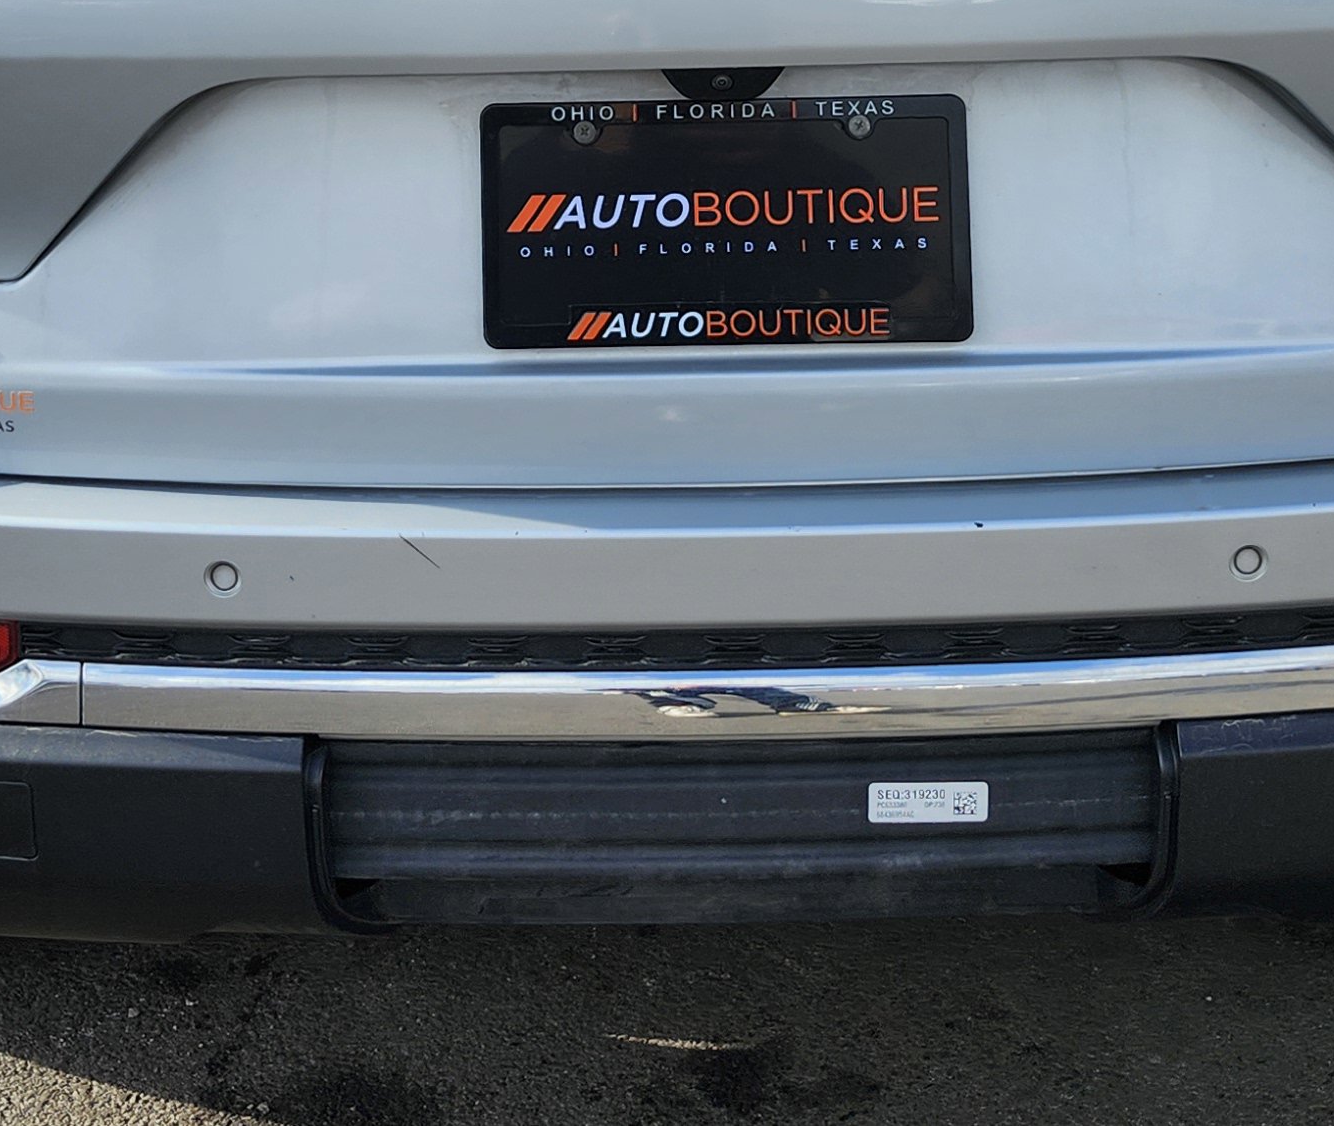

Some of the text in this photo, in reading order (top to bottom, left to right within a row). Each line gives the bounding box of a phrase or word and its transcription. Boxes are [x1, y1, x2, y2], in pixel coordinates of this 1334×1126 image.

[551, 99, 896, 122] OHIO FLORIDA TEXAS
[520, 237, 928, 259] OHIO FLORIDA TEXAS
[877, 789, 946, 800] SEQ:319230
